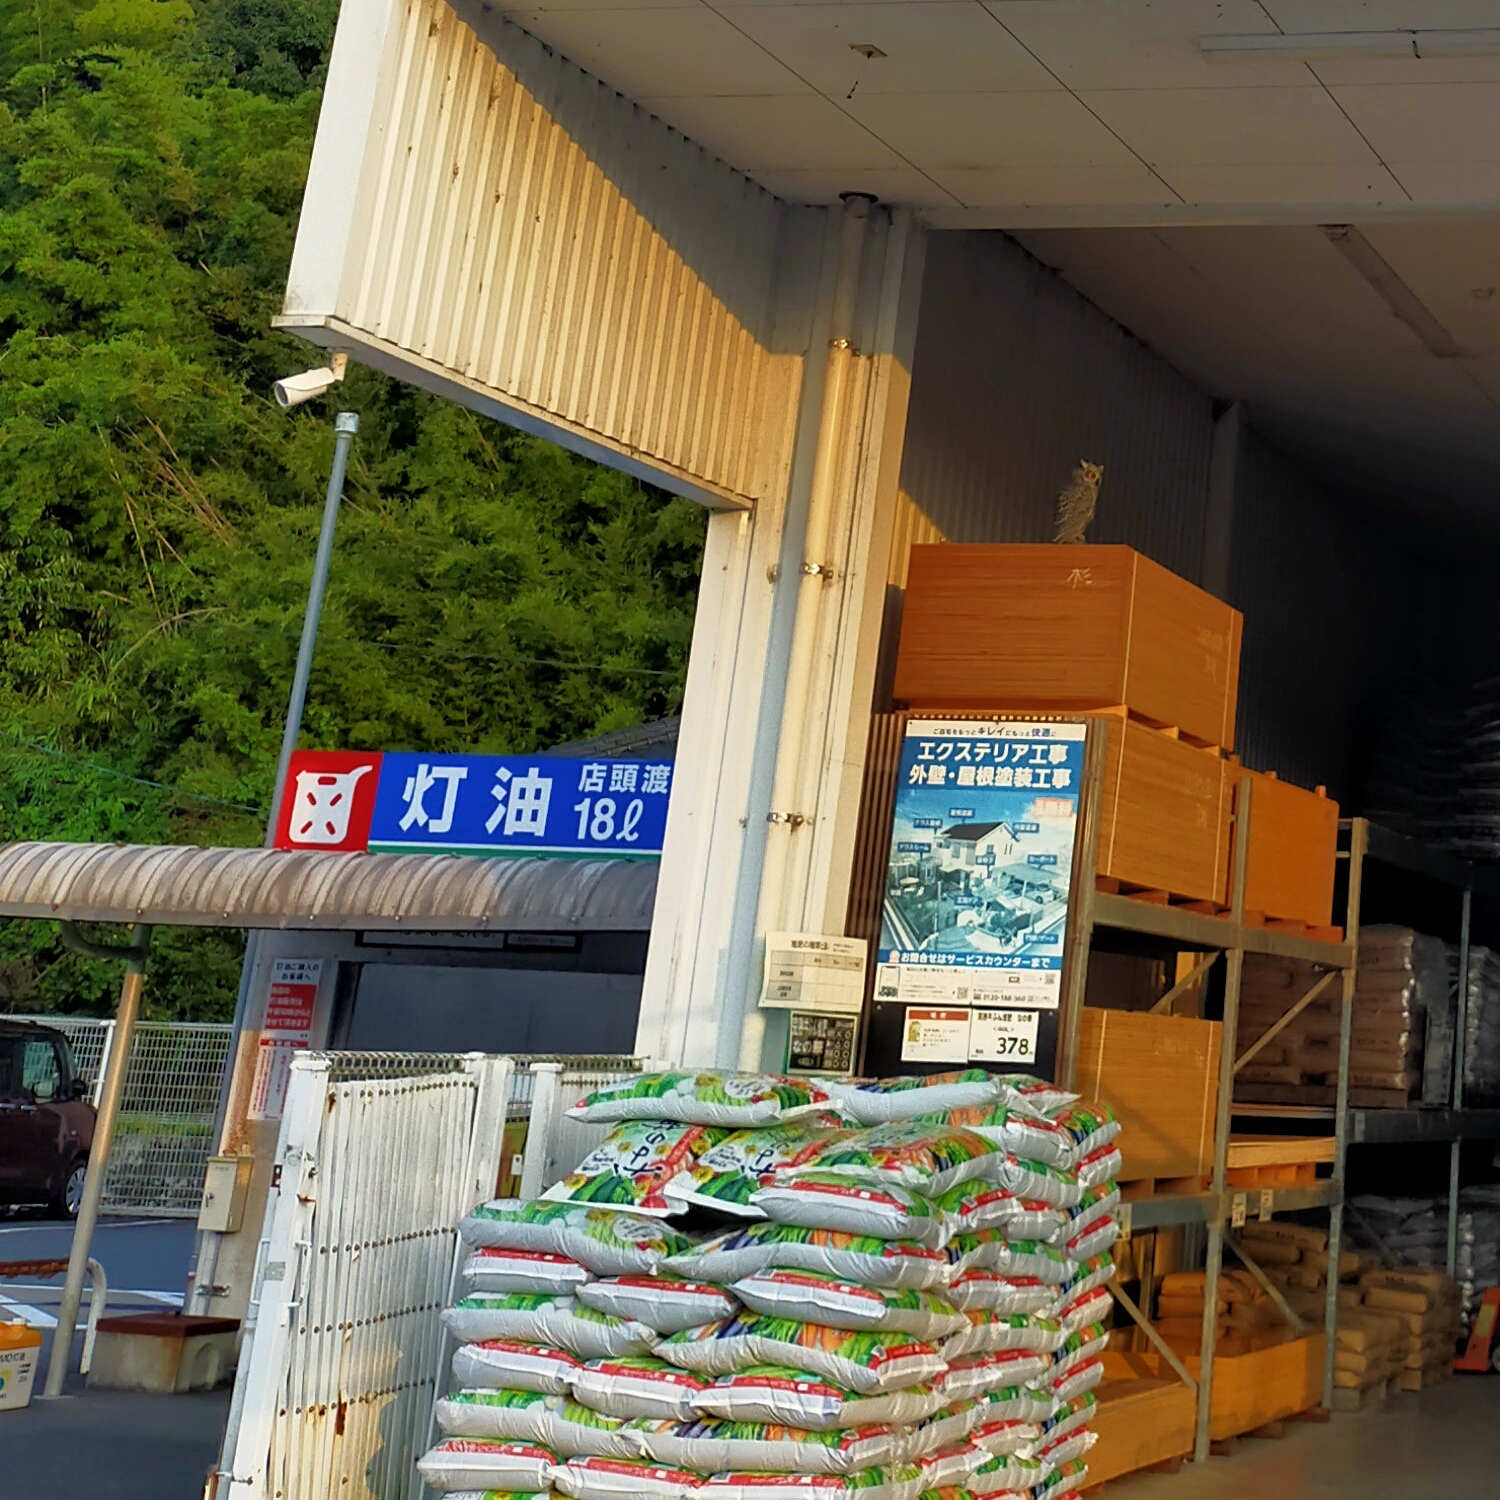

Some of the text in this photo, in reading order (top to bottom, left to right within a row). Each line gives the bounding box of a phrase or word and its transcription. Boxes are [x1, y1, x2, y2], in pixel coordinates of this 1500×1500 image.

[916, 741, 1069, 765] エクステリア工事
[577, 763, 672, 794] 店頭渡
[907, 763, 1072, 789] 外壁・屋根塗装工事
[399, 763, 553, 837] 灯油
[900, 952, 1051, 969] お問合せはサービスカウンターまで
[996, 1037, 1029, 1056] 378
